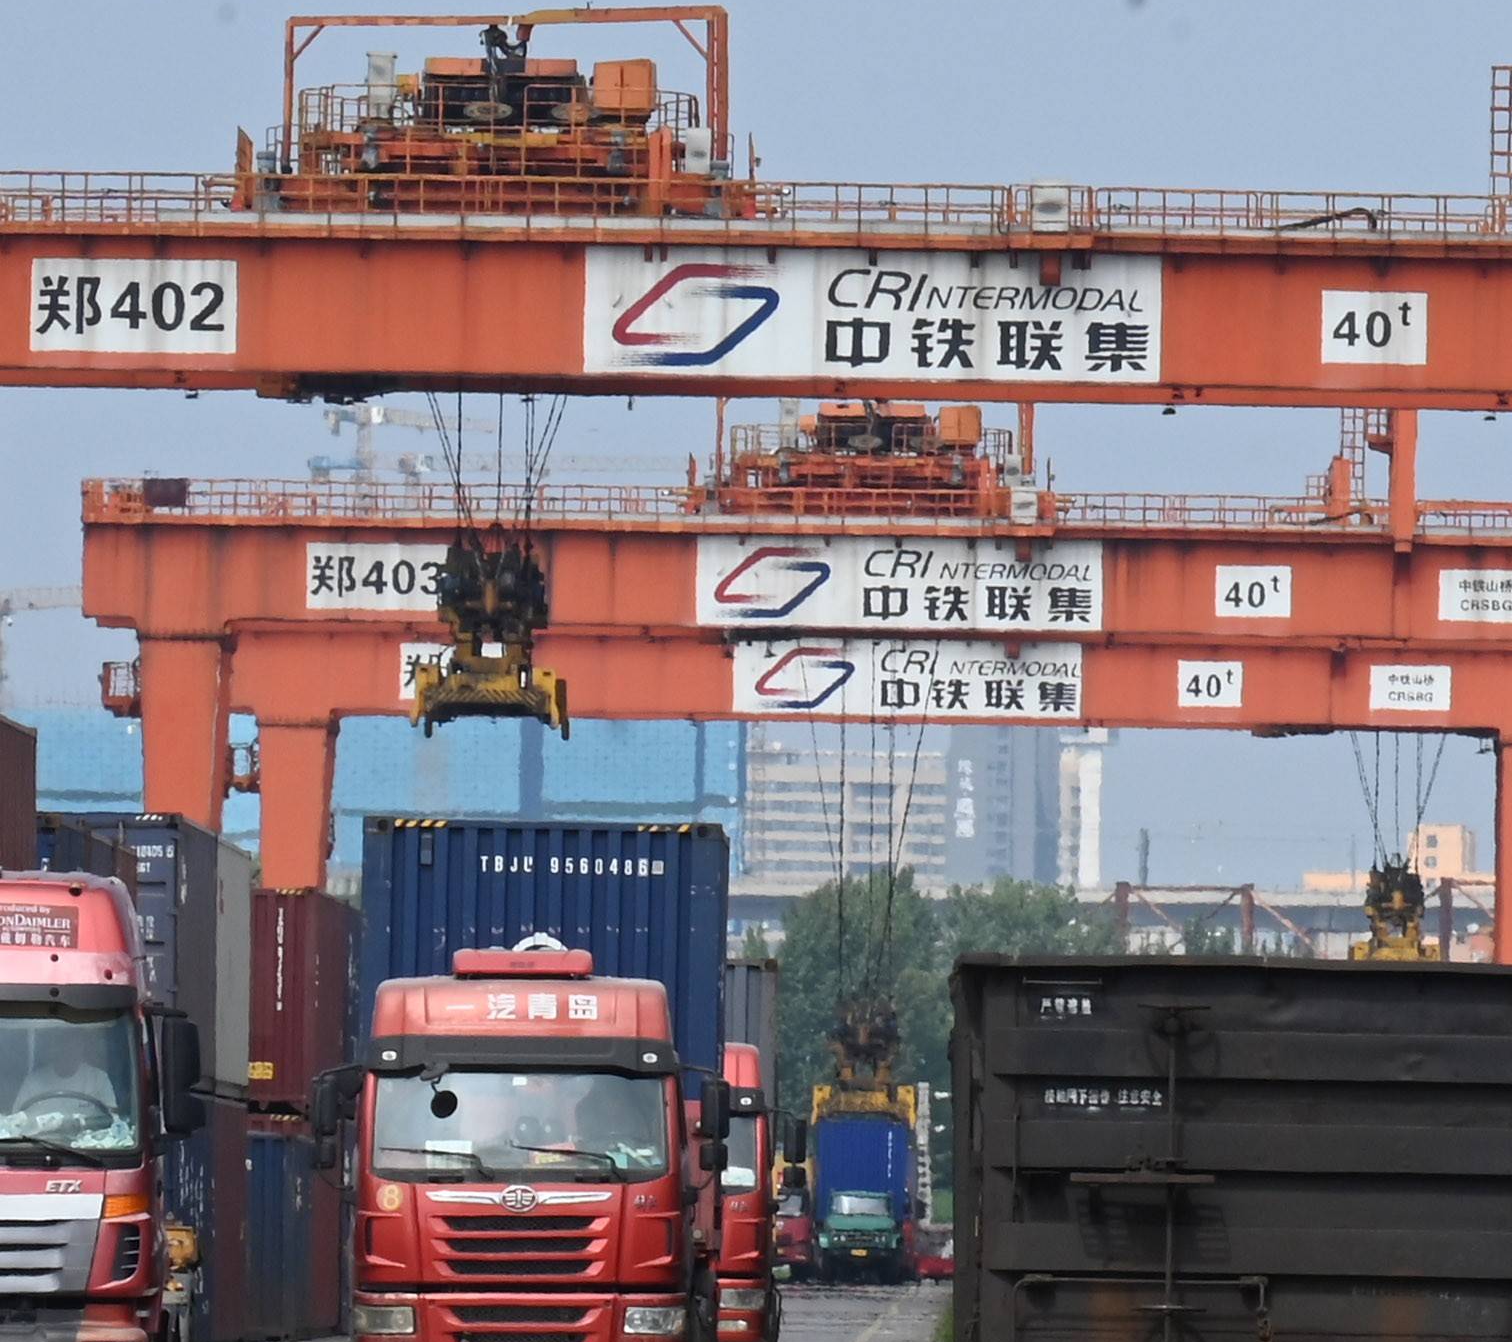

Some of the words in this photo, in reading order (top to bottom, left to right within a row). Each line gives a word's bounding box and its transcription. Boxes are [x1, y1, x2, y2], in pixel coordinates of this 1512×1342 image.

[36, 276, 225, 334] 郑402
[825, 317, 1150, 371] 中铁联集
[310, 555, 442, 597] 郑403
[863, 586, 1093, 623] 中铁联集
[1460, 597, 1512, 613] CRSBG
[880, 679, 1077, 712] 中铁联集
[480, 856, 533, 873] TBJU
[551, 857, 648, 876] 9560486
[446, 993, 597, 1020] 一汽青岛
